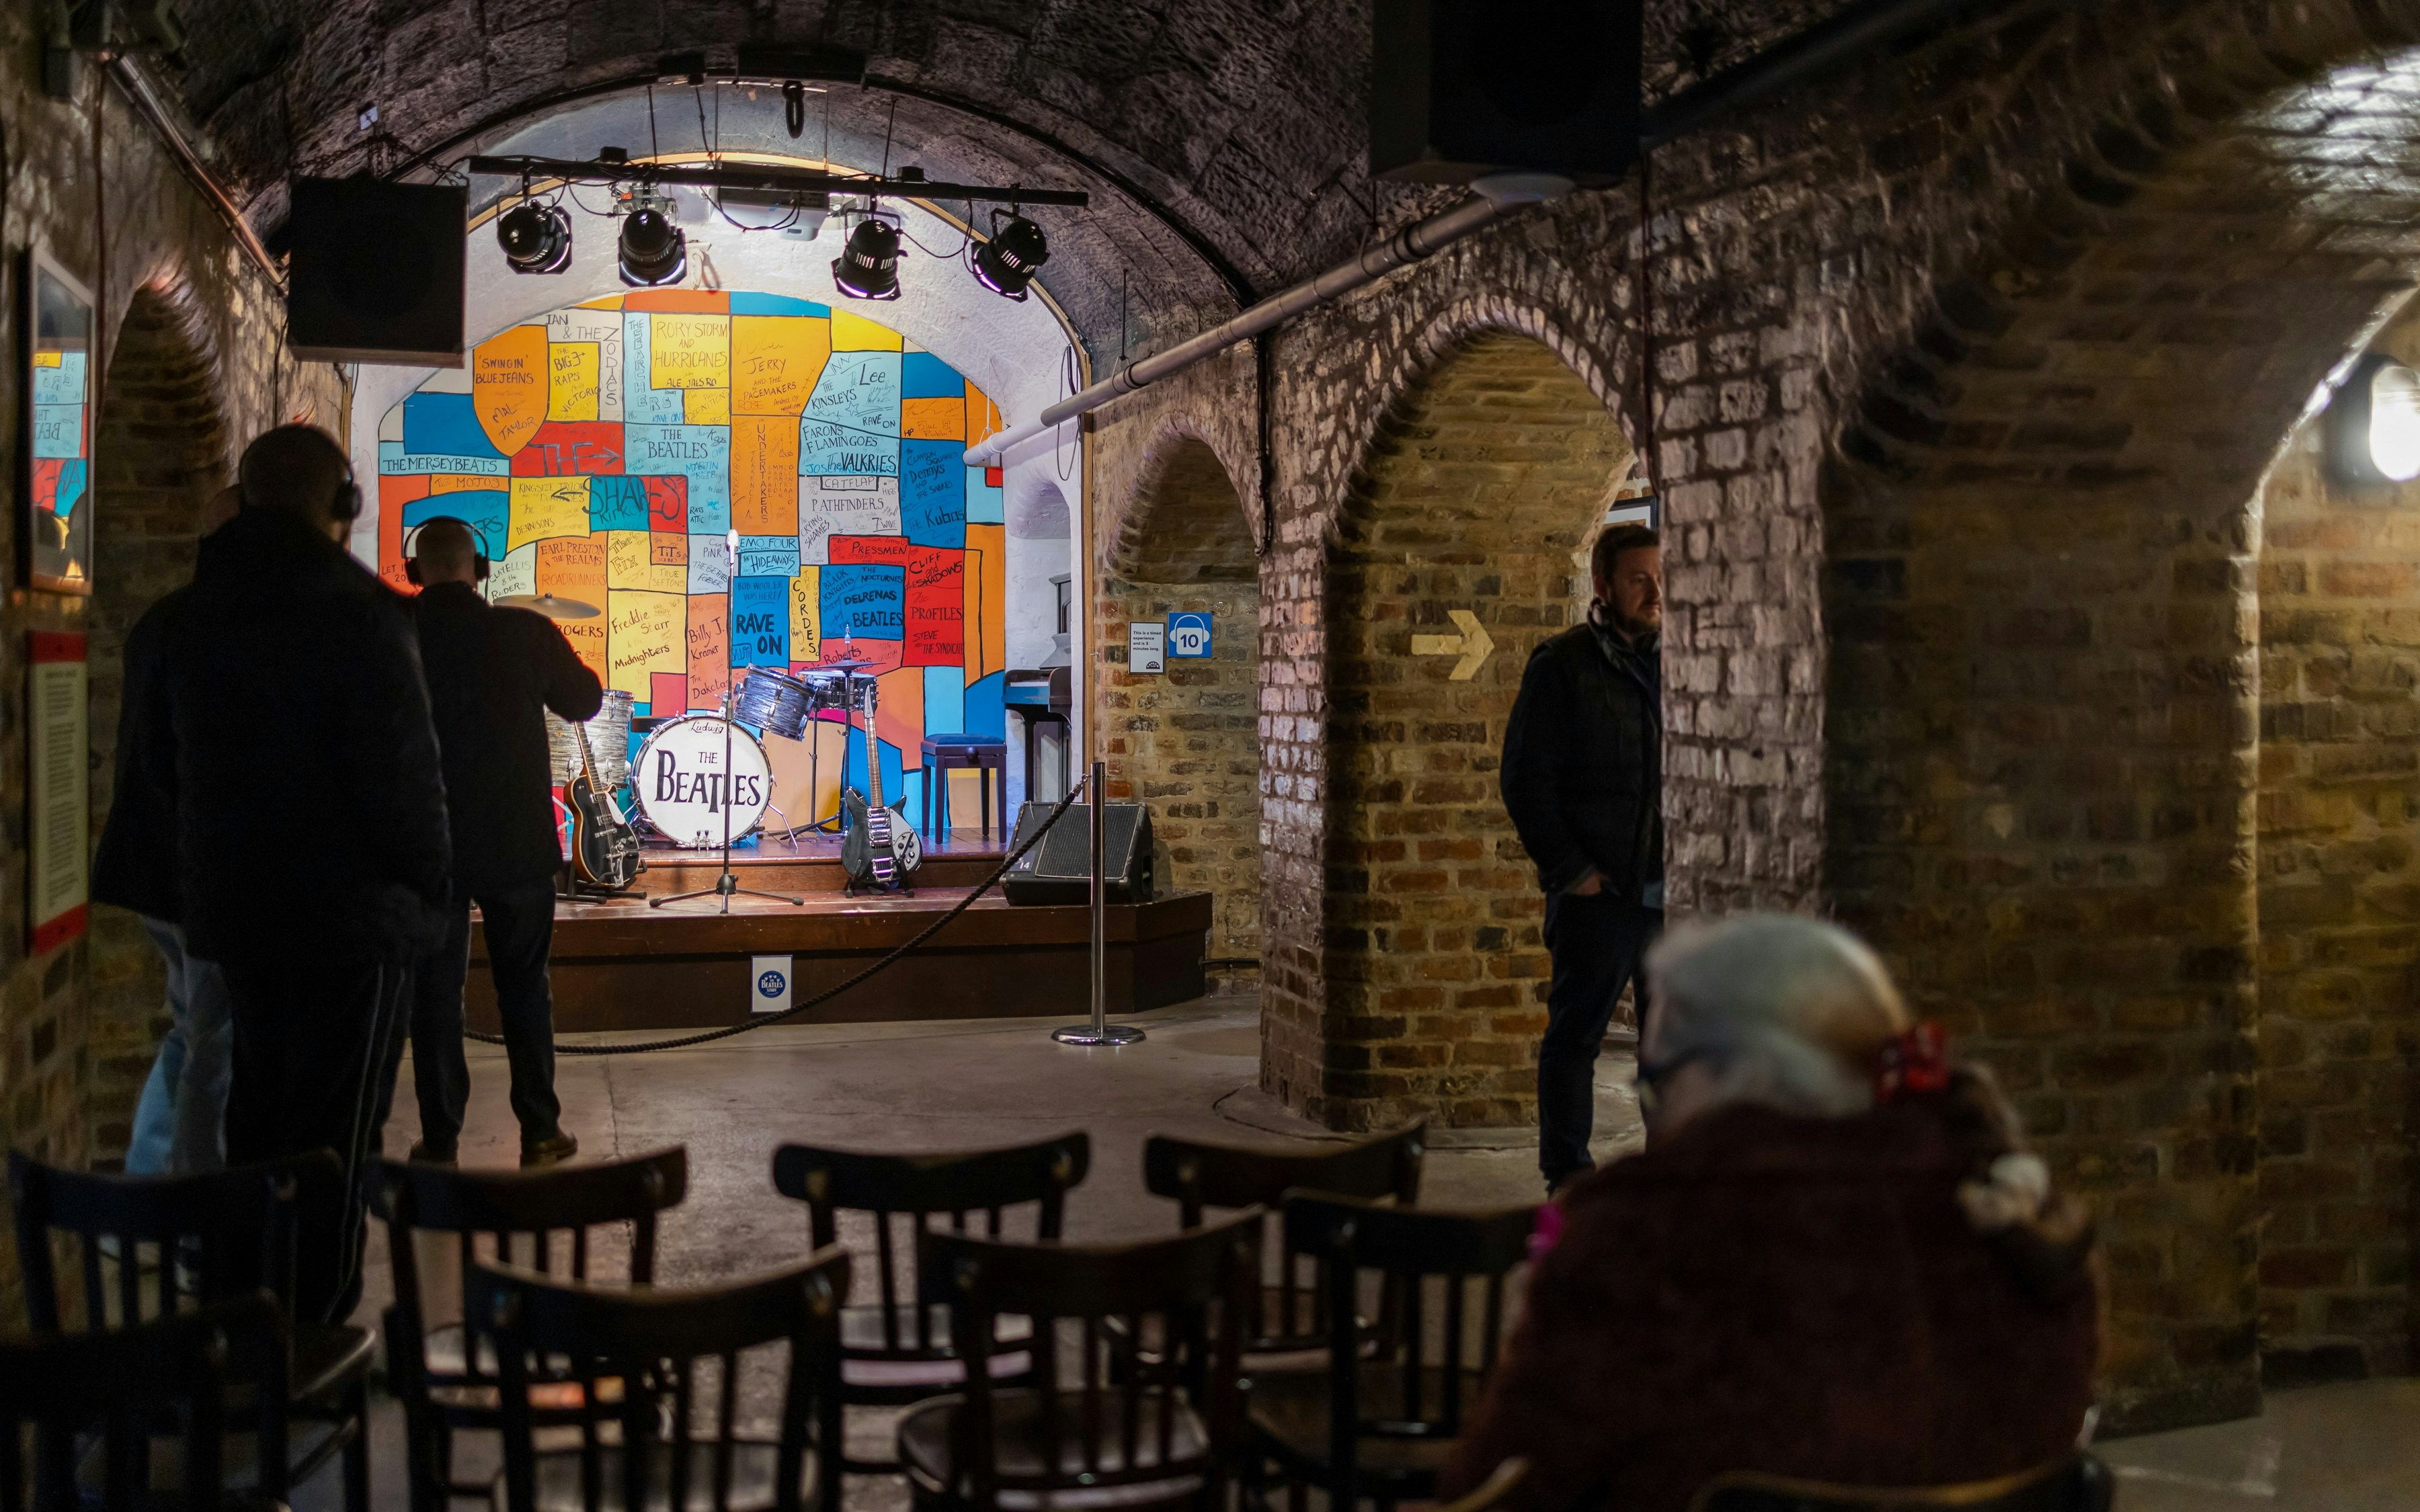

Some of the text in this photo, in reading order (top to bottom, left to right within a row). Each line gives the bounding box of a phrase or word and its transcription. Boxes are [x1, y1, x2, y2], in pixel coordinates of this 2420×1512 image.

[545, 314, 569, 325] IAN
[629, 319, 644, 330] THE
[563, 326, 602, 340] & THE
[656, 321, 728, 339] RORY STORM
[555, 346, 570, 355] THE
[679, 339, 695, 348] AND
[554, 355, 572, 372] BIG
[603, 326, 620, 406] ZODIACS
[654, 349, 728, 368] HURRICANES
[742, 357, 787, 374] JERRY
[499, 372, 534, 384] JEANS
[554, 371, 581, 386] RAPS
[666, 378, 682, 387] ALE
[769, 376, 782, 384] THE
[859, 364, 886, 386] Lee
[743, 381, 797, 401] PACEMAKERS
[819, 379, 834, 393] THE
[811, 388, 858, 410] KINSLEYS
[492, 403, 518, 423] MAL
[499, 416, 538, 440] TAYLOR
[862, 414, 896, 428] RAVE ON
[661, 429, 682, 440] THE
[802, 425, 844, 441] FARONS
[647, 441, 709, 460] BEATLES
[806, 436, 878, 454] FLAMINGOES
[382, 457, 497, 473] THE MERSEYBEATS
[841, 452, 897, 473] VALKRIES
[757, 424, 768, 523] UNDERTAKERS
[456, 476, 500, 489] MOJOS
[519, 482, 553, 493] KINGSIZE
[824, 476, 875, 489] CATFLAP
[915, 479, 928, 490] AND
[929, 480, 953, 495] SABRES
[812, 497, 885, 512] PATHFINDERS
[516, 517, 555, 536] DENNISONS
[800, 514, 823, 537] CRYING
[540, 542, 606, 555] EARL PRESTON
[608, 536, 633, 554] The
[735, 538, 765, 548] EMO
[769, 538, 797, 549] FOUR
[852, 542, 908, 556] PRESSMEN
[551, 554, 565, 563] THE
[566, 554, 603, 566] REALMS
[751, 554, 795, 573] HIDEAWAYS
[909, 551, 942, 574] CLIFF
[542, 573, 607, 586] ROADRUNNERS
[823, 569, 849, 590] BLACK
[861, 575, 903, 583] NOCTURNES
[916, 560, 963, 588] SHADOWS
[737, 580, 783, 591] BOB WOOLER
[822, 577, 855, 601] KNIGHTS
[743, 593, 758, 601] WAS
[852, 611, 903, 628] BEATLES
[910, 607, 963, 621] PROFILES
[612, 610, 650, 634] Freddie
[641, 620, 670, 634] Starr
[736, 613, 774, 634] RAVE
[688, 624, 712, 648] Billy
[913, 630, 940, 642] STEVE
[1180, 634, 1199, 648] 10
[690, 644, 719, 661] Kramer
[757, 635, 782, 656] ON
[934, 643, 963, 655] SYNDICATE
[614, 644, 671, 670] Midnighters
[823, 646, 862, 665] Roberts
[690, 674, 701, 684] The
[688, 721, 725, 734] Ludwig
[698, 751, 718, 764] THE
[654, 749, 761, 813] BEATLES
[761, 979, 784, 989] BEATLES
